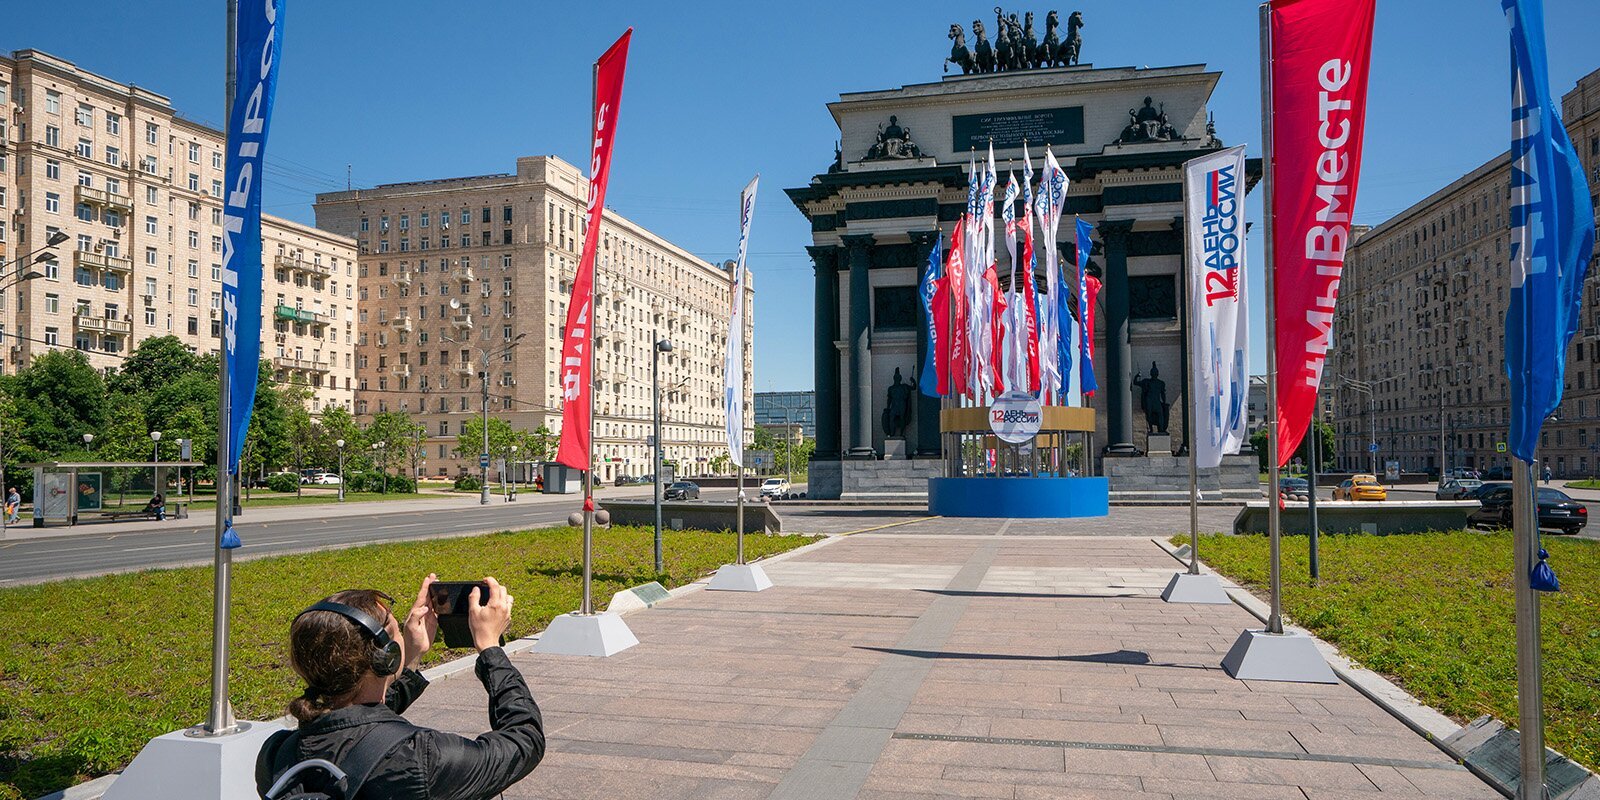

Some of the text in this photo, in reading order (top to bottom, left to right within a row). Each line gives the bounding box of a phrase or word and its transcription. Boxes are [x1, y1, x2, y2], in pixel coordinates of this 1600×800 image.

[1217, 164, 1240, 270] РОССИИ
[1202, 204, 1235, 308] 12 ДЕНЬ
[992, 410, 1004, 420] 12
[1004, 415, 1039, 423] РОССИИ
